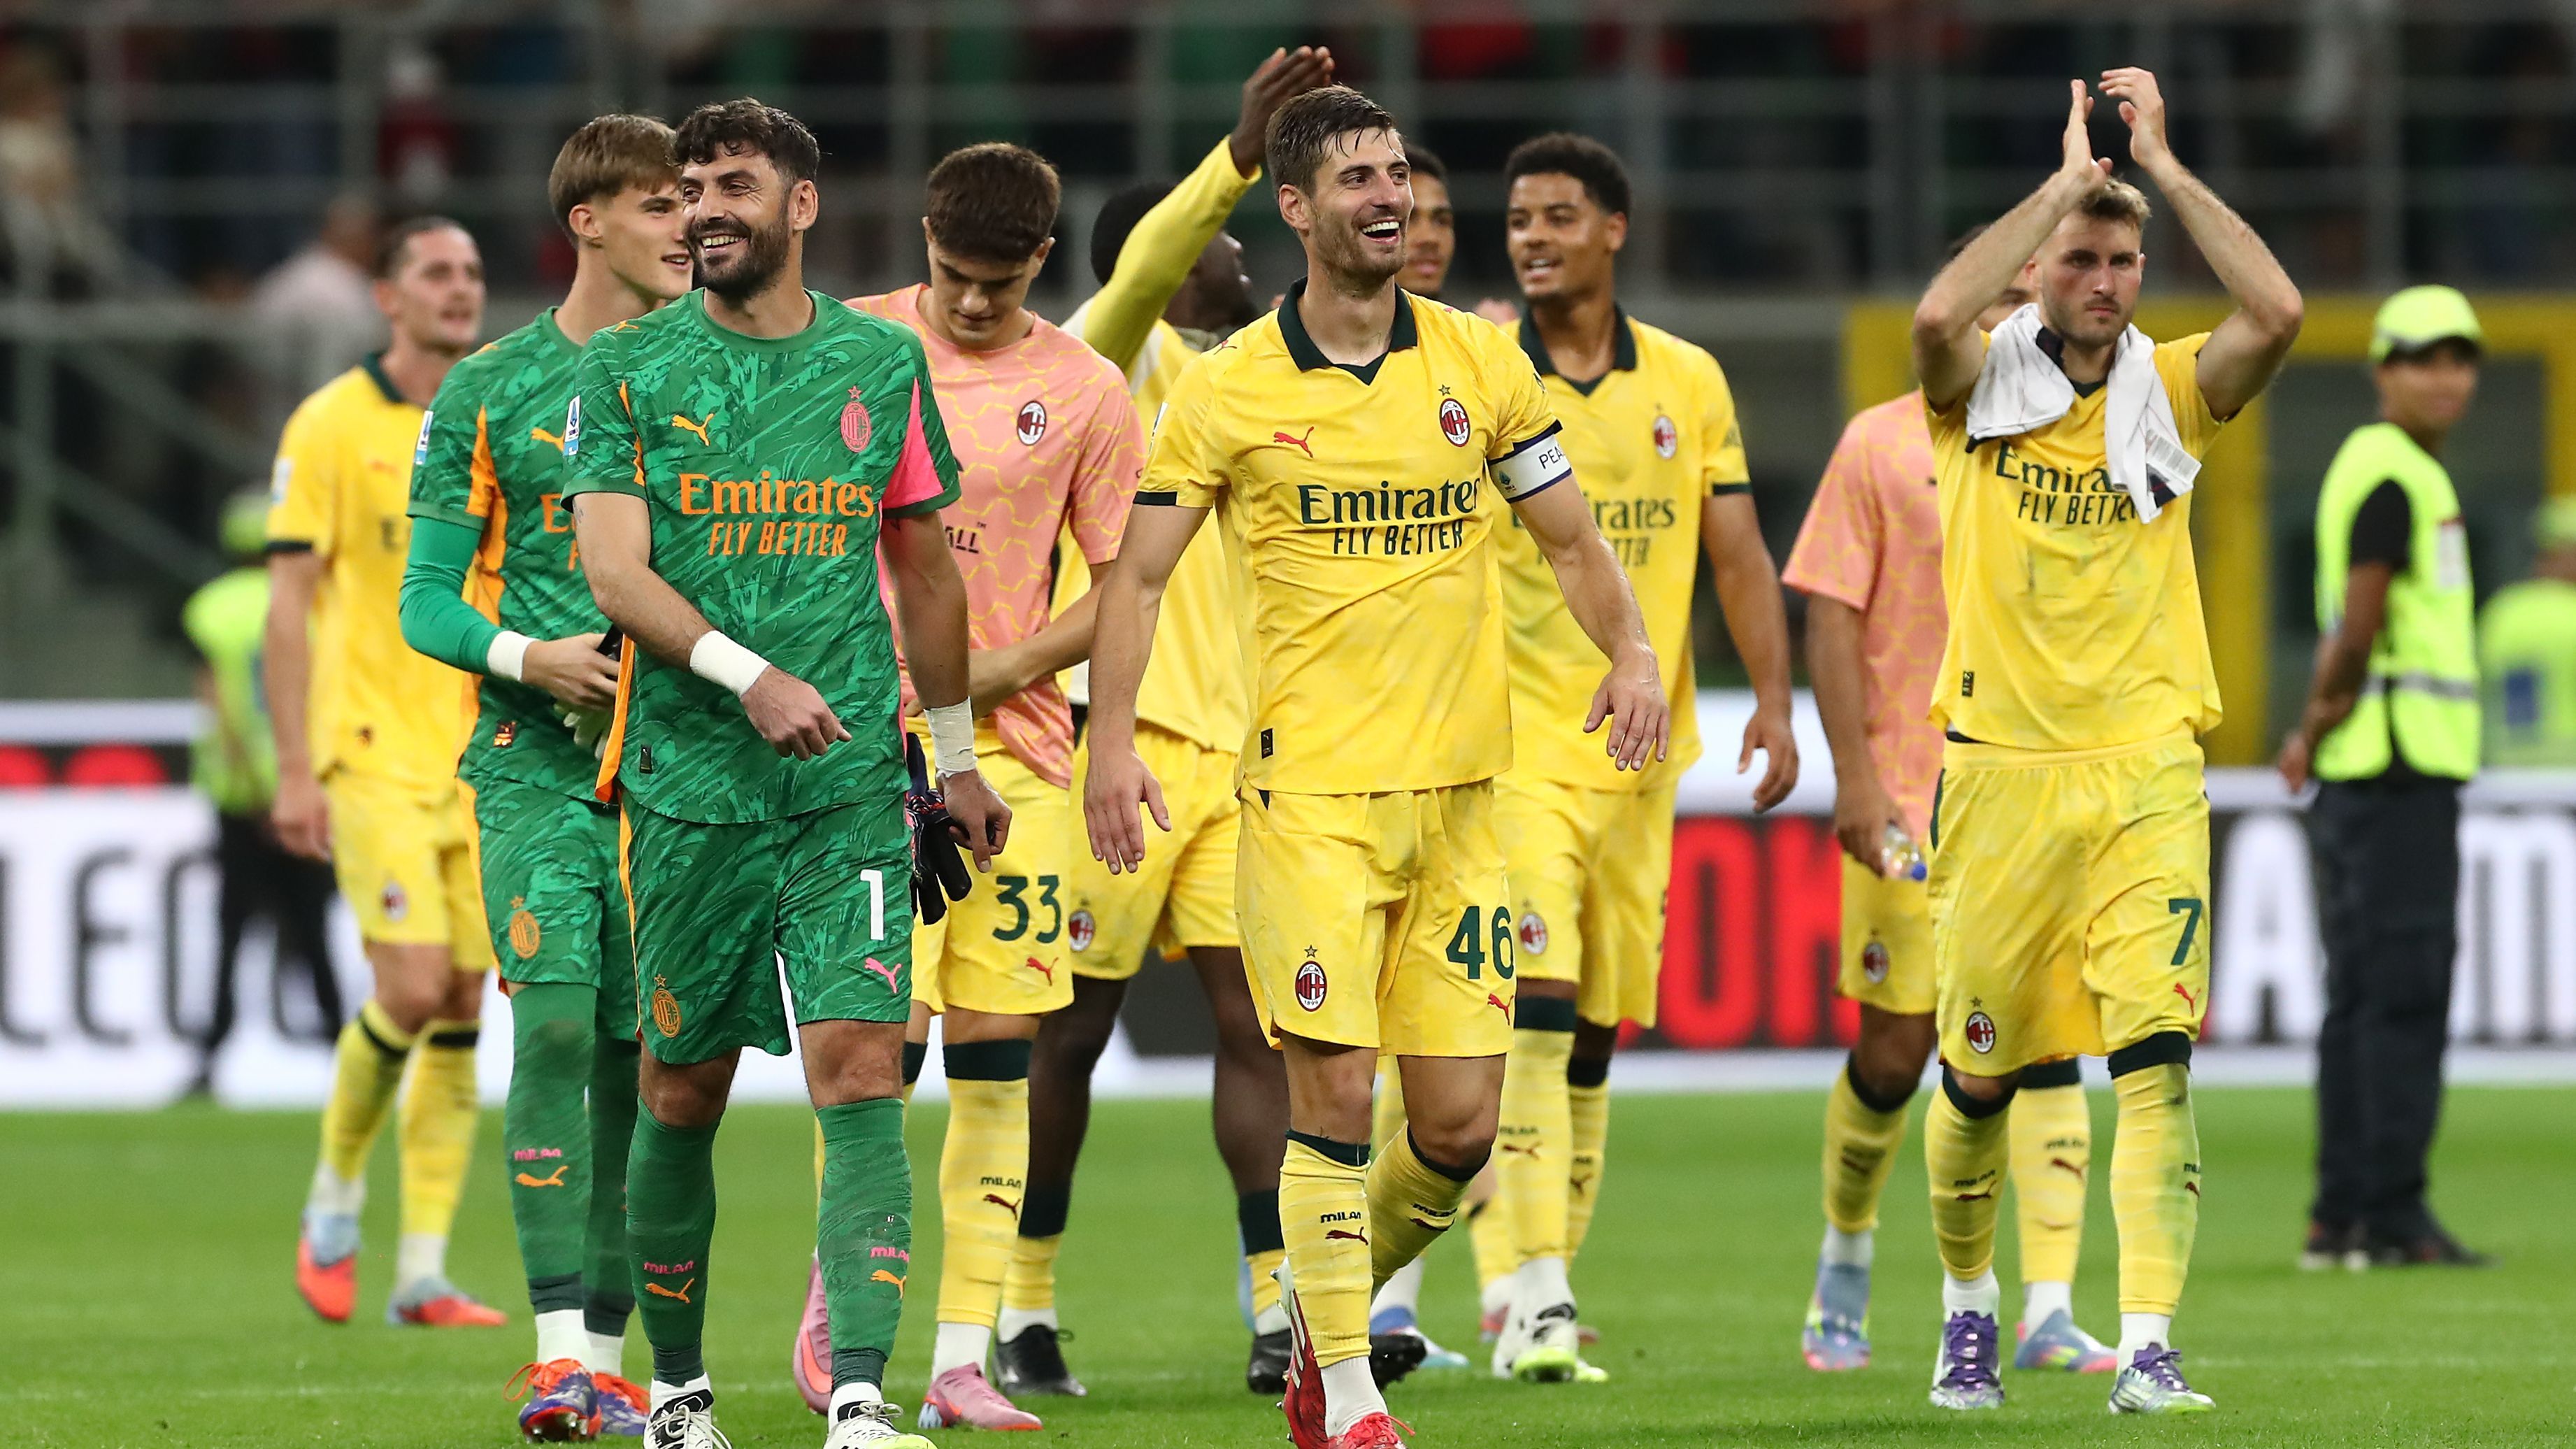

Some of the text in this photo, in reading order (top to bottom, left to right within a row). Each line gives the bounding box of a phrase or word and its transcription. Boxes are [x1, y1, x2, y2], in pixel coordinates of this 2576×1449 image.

[1996, 439, 2115, 493] Emira
[678, 470, 875, 518] Emirates
[2018, 491, 2058, 524] FLY
[708, 521, 847, 557] FLY BETTER
[1333, 519, 1464, 555] FLY BETTER
[860, 869, 885, 941] 1
[992, 875, 1061, 944] 33
[2168, 898, 2202, 966] 7
[1445, 906, 1515, 980] 46
